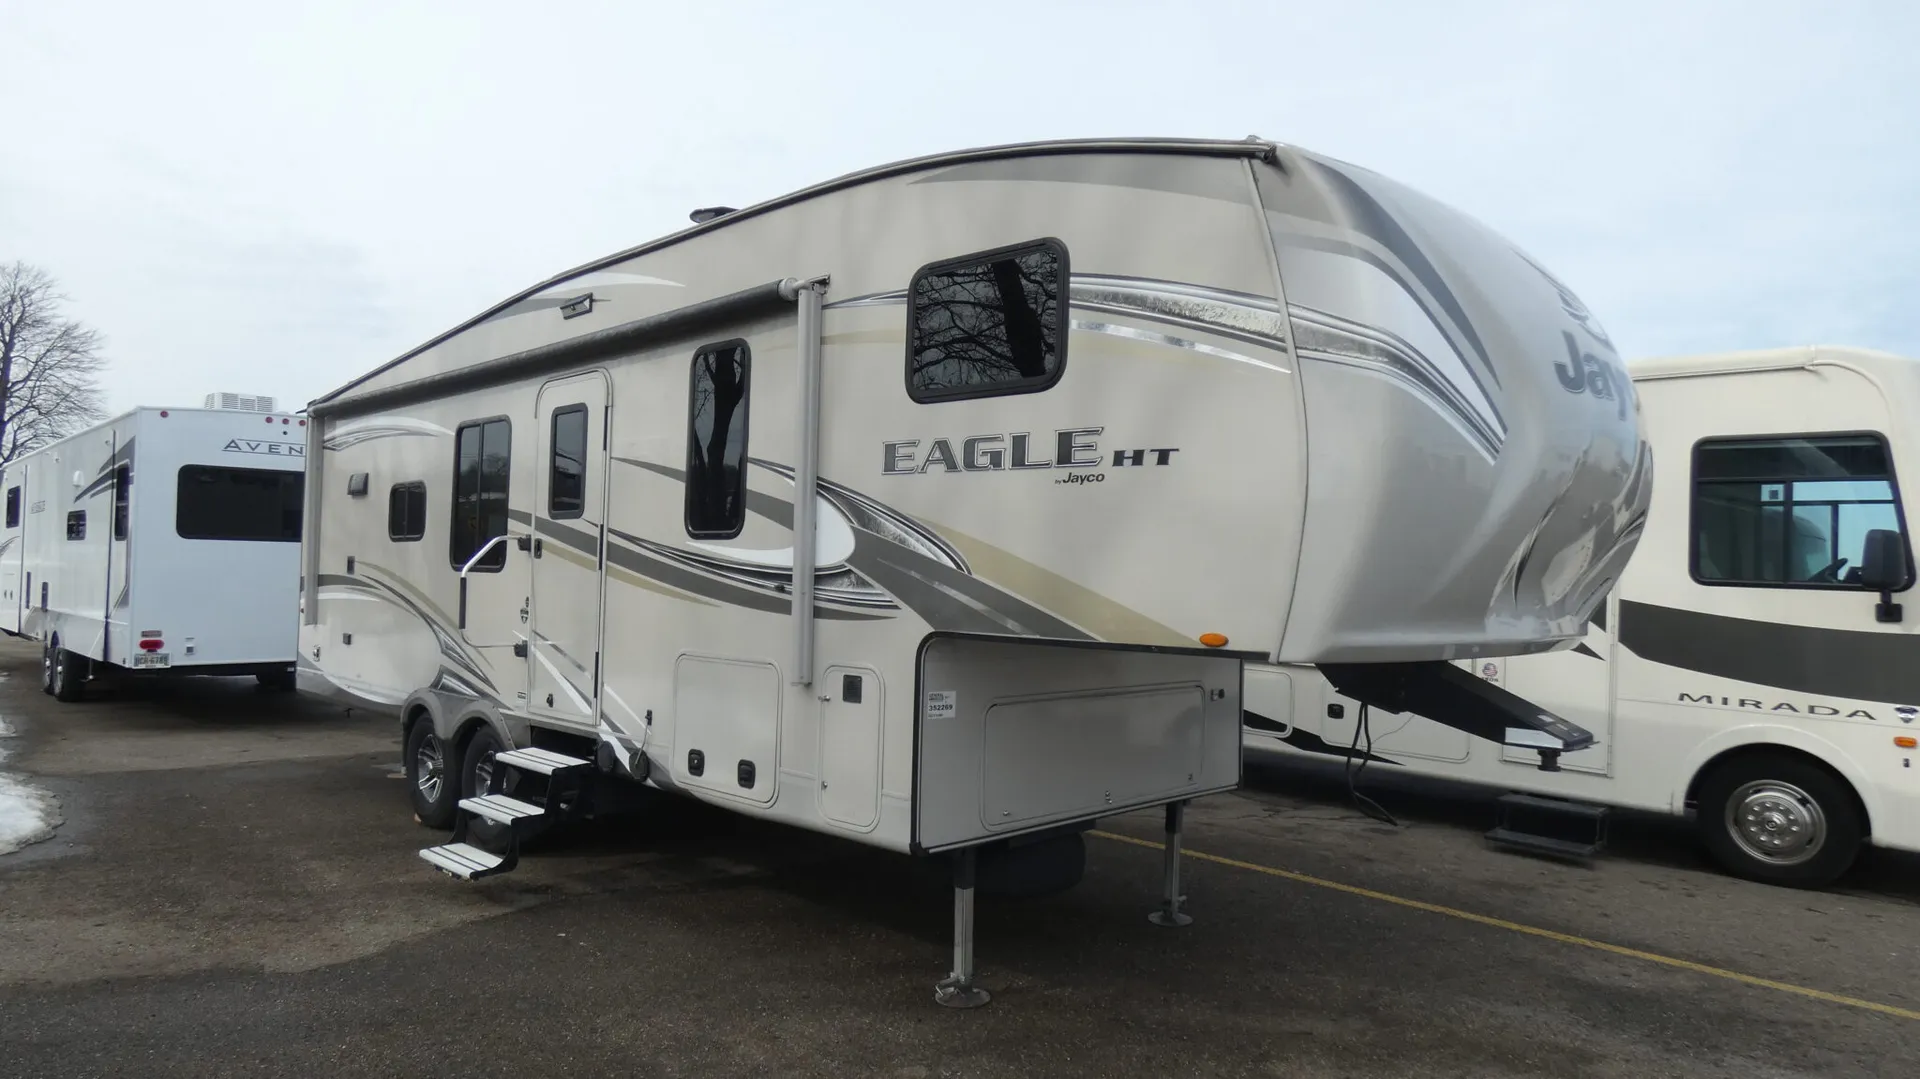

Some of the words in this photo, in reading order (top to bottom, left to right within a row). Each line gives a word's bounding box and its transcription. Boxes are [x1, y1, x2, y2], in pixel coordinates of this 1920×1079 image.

[881, 426, 1105, 475] EAGLE
[1111, 448, 1180, 467] HT
[1062, 471, 1105, 486] Jayco
[928, 704, 953, 712] 352269
[1677, 692, 1878, 721] MIRADA
